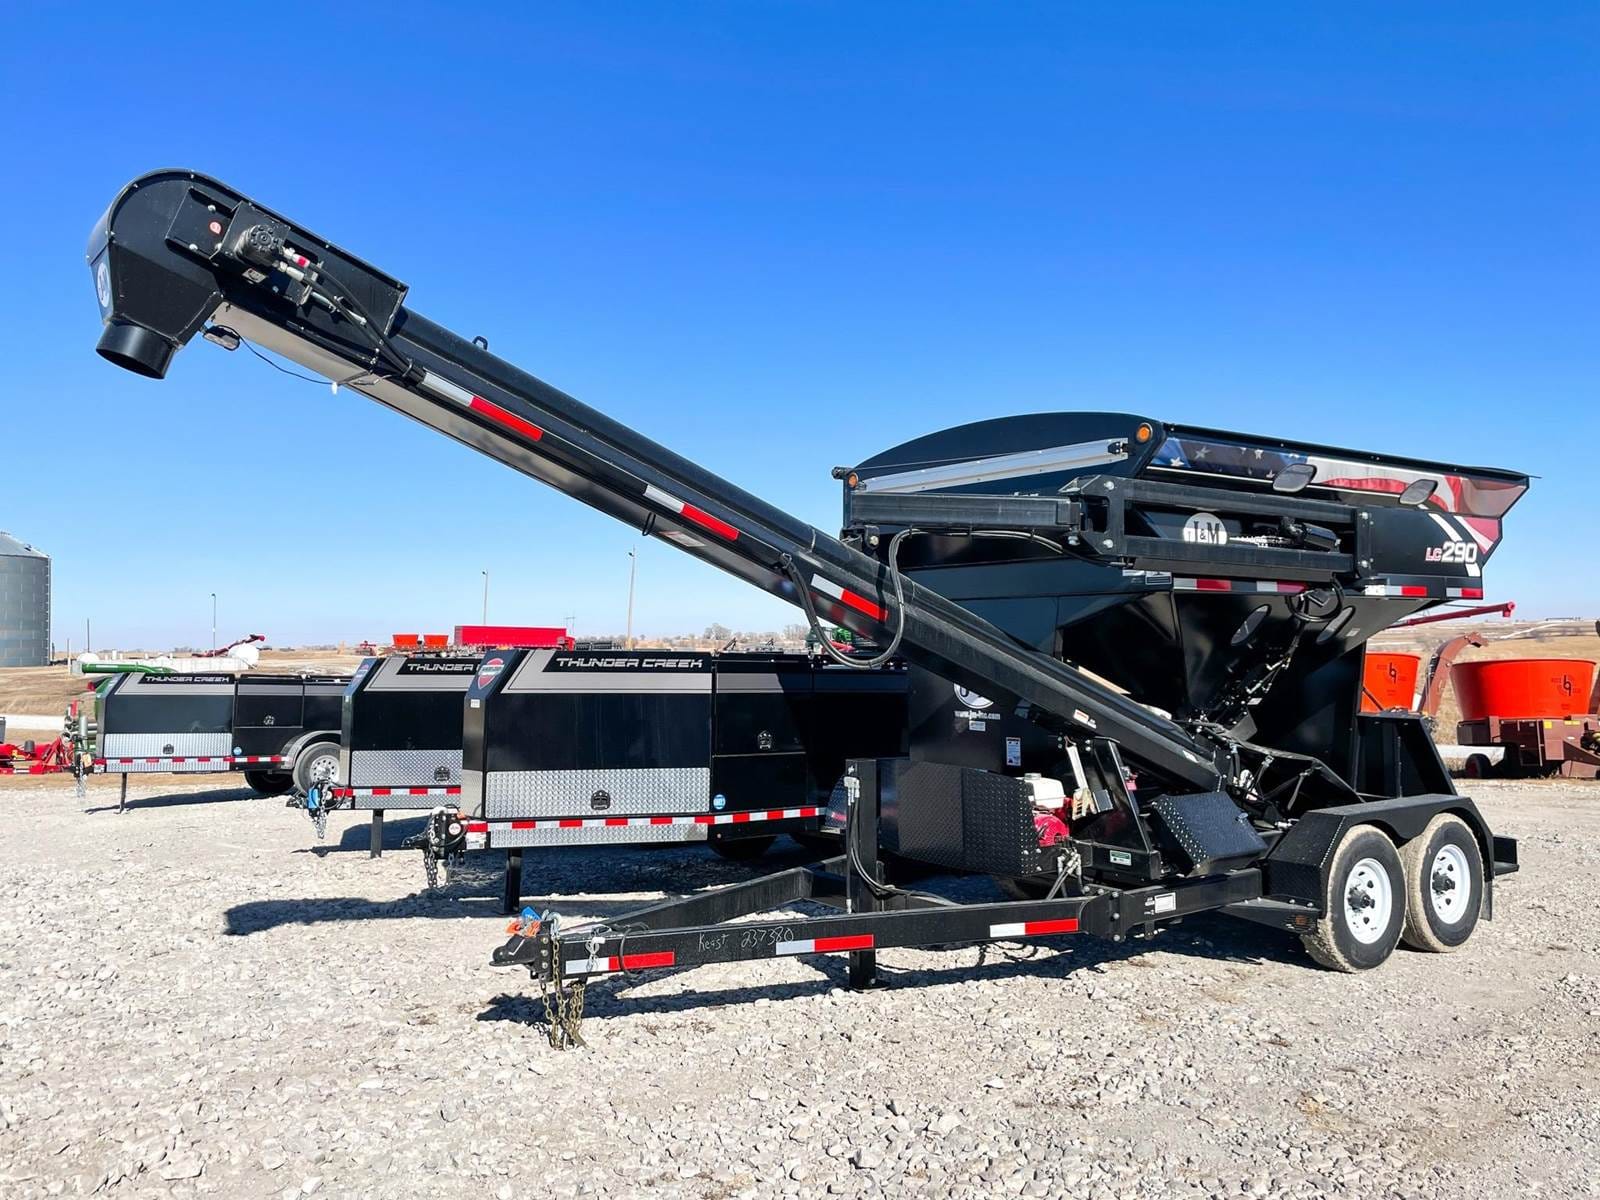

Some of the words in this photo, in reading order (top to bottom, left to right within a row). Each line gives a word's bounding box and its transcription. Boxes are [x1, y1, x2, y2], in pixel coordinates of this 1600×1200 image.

[407, 663, 474, 672] THUNDER
[556, 657, 639, 668] THUNDER
[642, 659, 703, 669] CREEK
[741, 926, 794, 948] 237380
